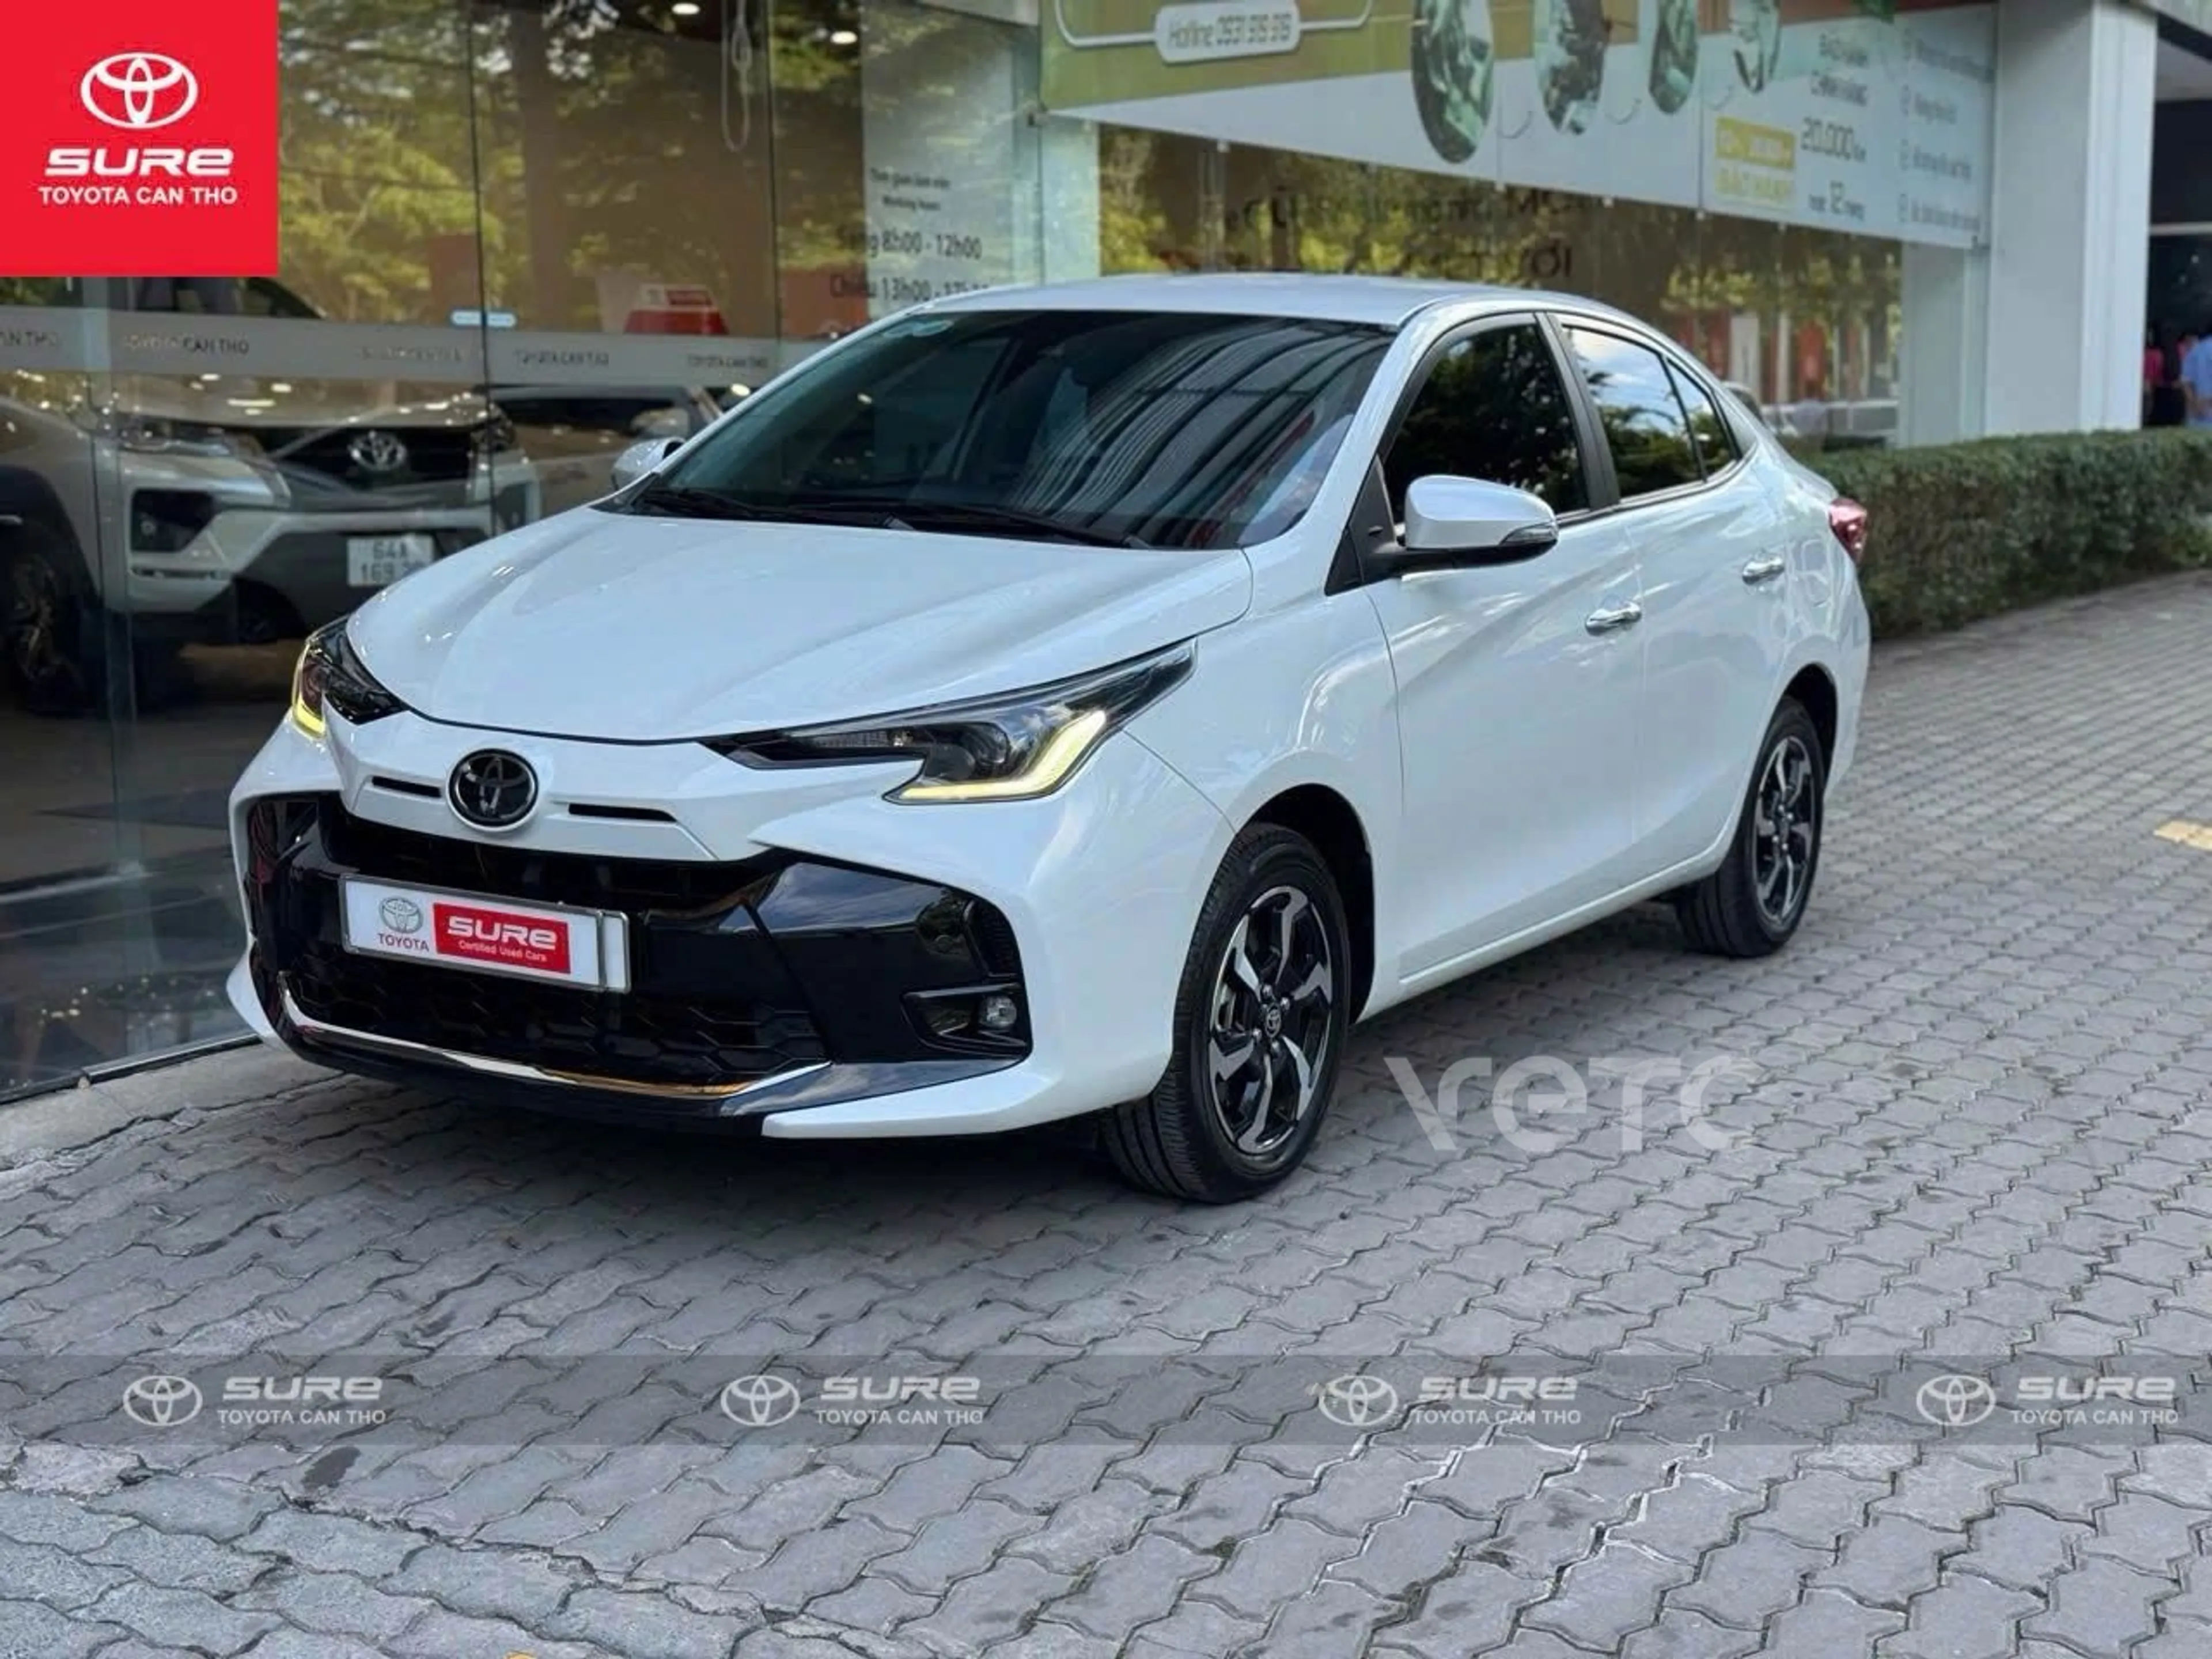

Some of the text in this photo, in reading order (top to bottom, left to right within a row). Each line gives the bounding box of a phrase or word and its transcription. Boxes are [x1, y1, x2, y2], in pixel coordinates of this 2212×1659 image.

[935, 233, 983, 260] 12h00
[377, 933, 430, 953] TOYOTA
[458, 940, 548, 962] Certified Used Cars
